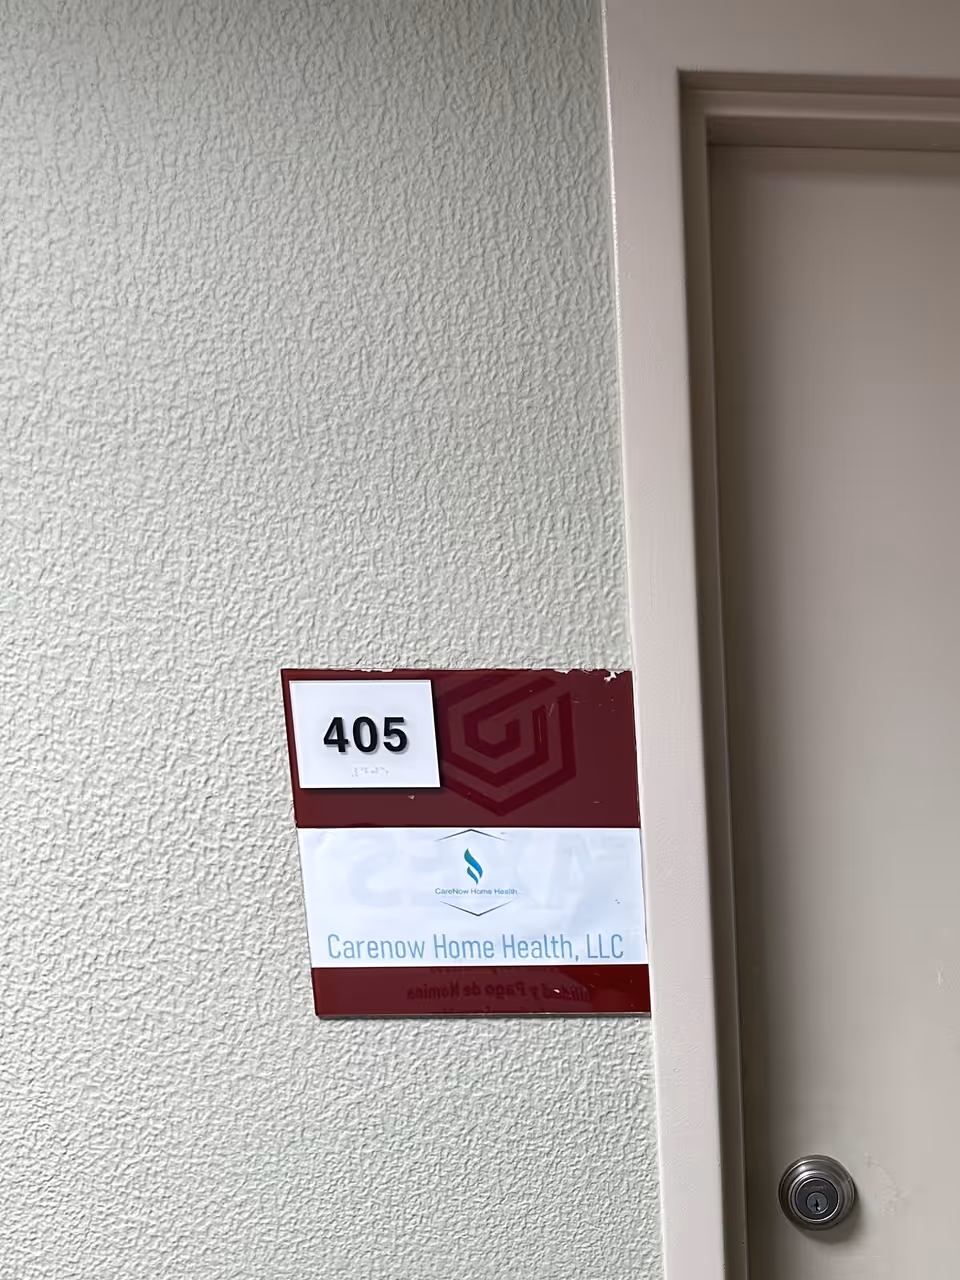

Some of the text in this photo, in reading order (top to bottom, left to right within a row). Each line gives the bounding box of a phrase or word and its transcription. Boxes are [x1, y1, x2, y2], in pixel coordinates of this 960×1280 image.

[323, 716, 408, 753] 405
[434, 887, 469, 895] CareNow
[494, 887, 518, 895] Health
[327, 933, 624, 962] Carenow Home Health, LLC
